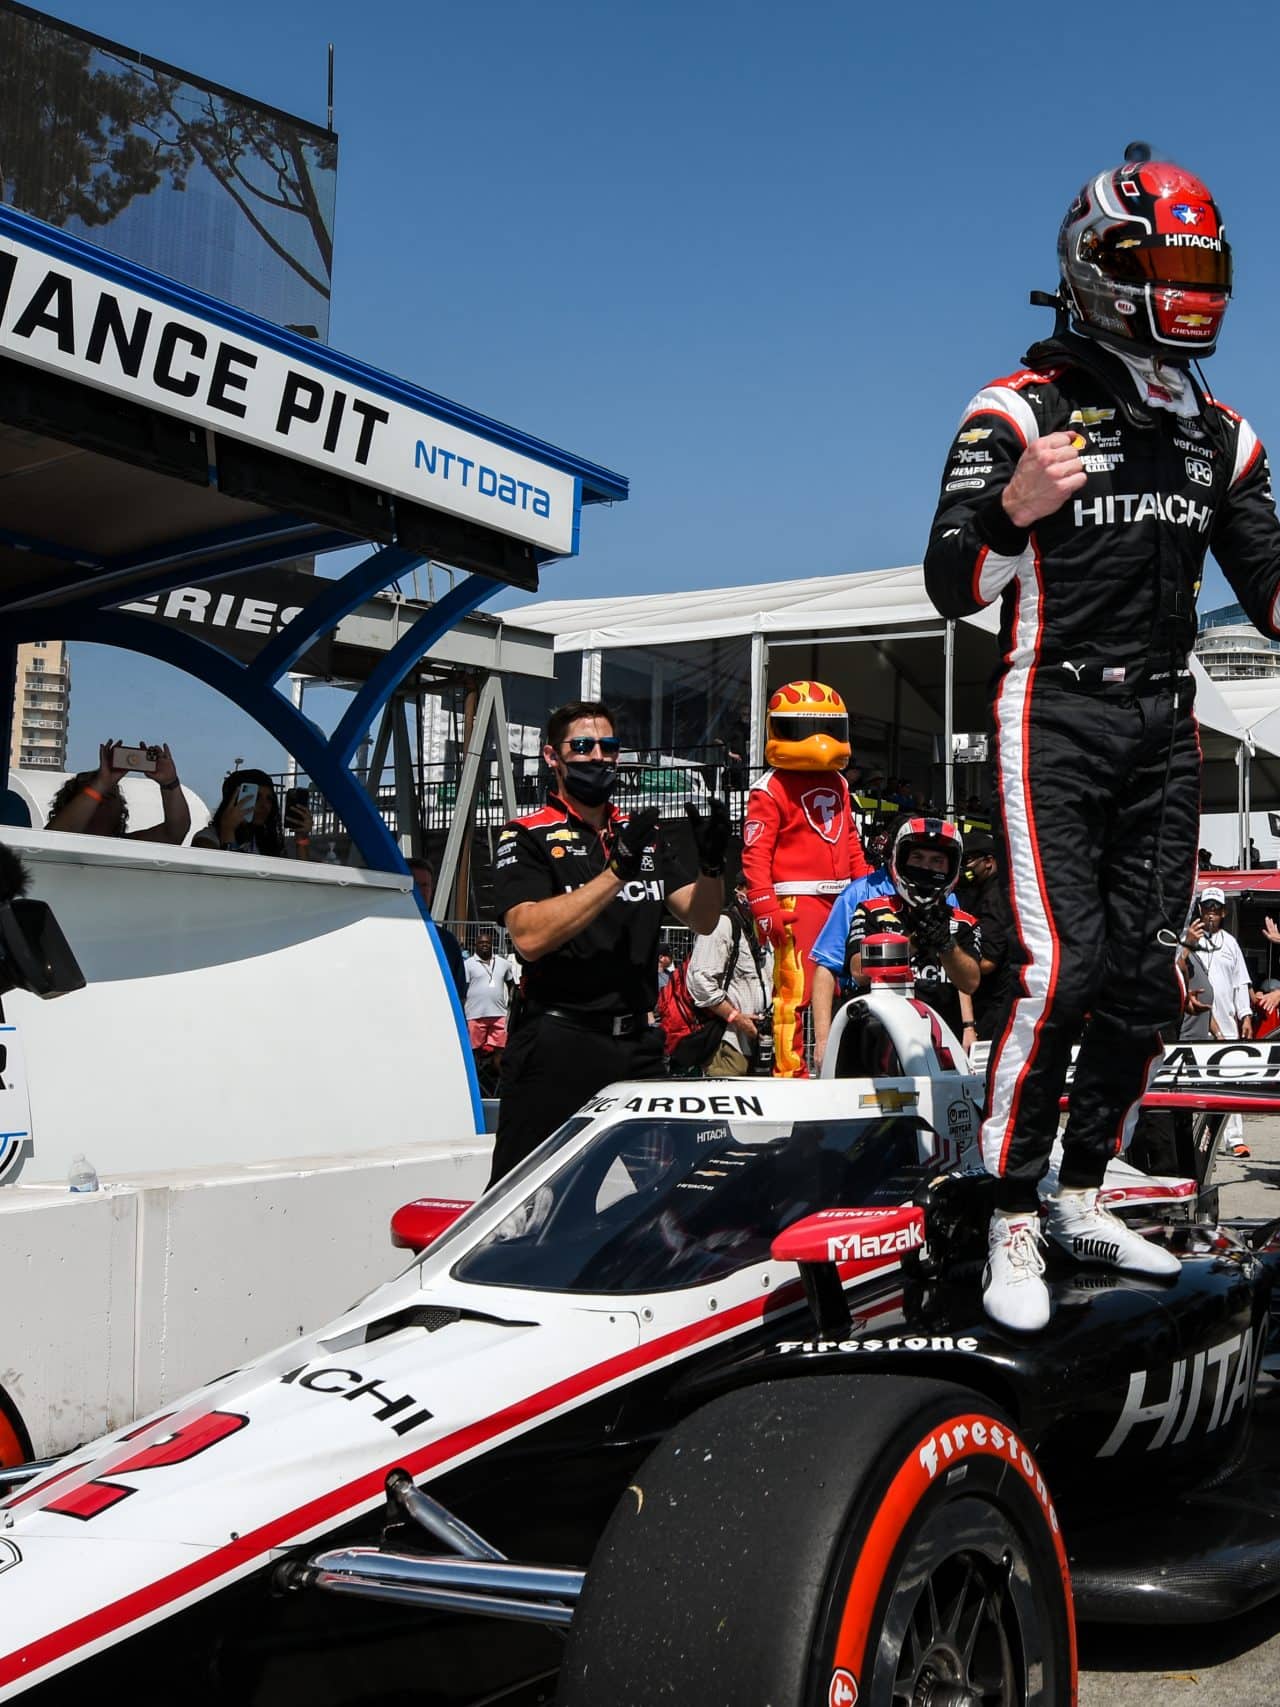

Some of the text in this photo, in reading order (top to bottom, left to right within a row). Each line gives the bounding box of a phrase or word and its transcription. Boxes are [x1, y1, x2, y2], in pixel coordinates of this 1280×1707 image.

[1166, 234, 1221, 252] HITACHI
[0, 251, 389, 465] ANCE PIT
[414, 439, 475, 487] NTT
[817, 1210, 899, 1218] SIEMENS
[828, 1221, 924, 1262] Mazak
[775, 1336, 979, 1354] Firestone
[919, 1421, 1059, 1533] Firestone
